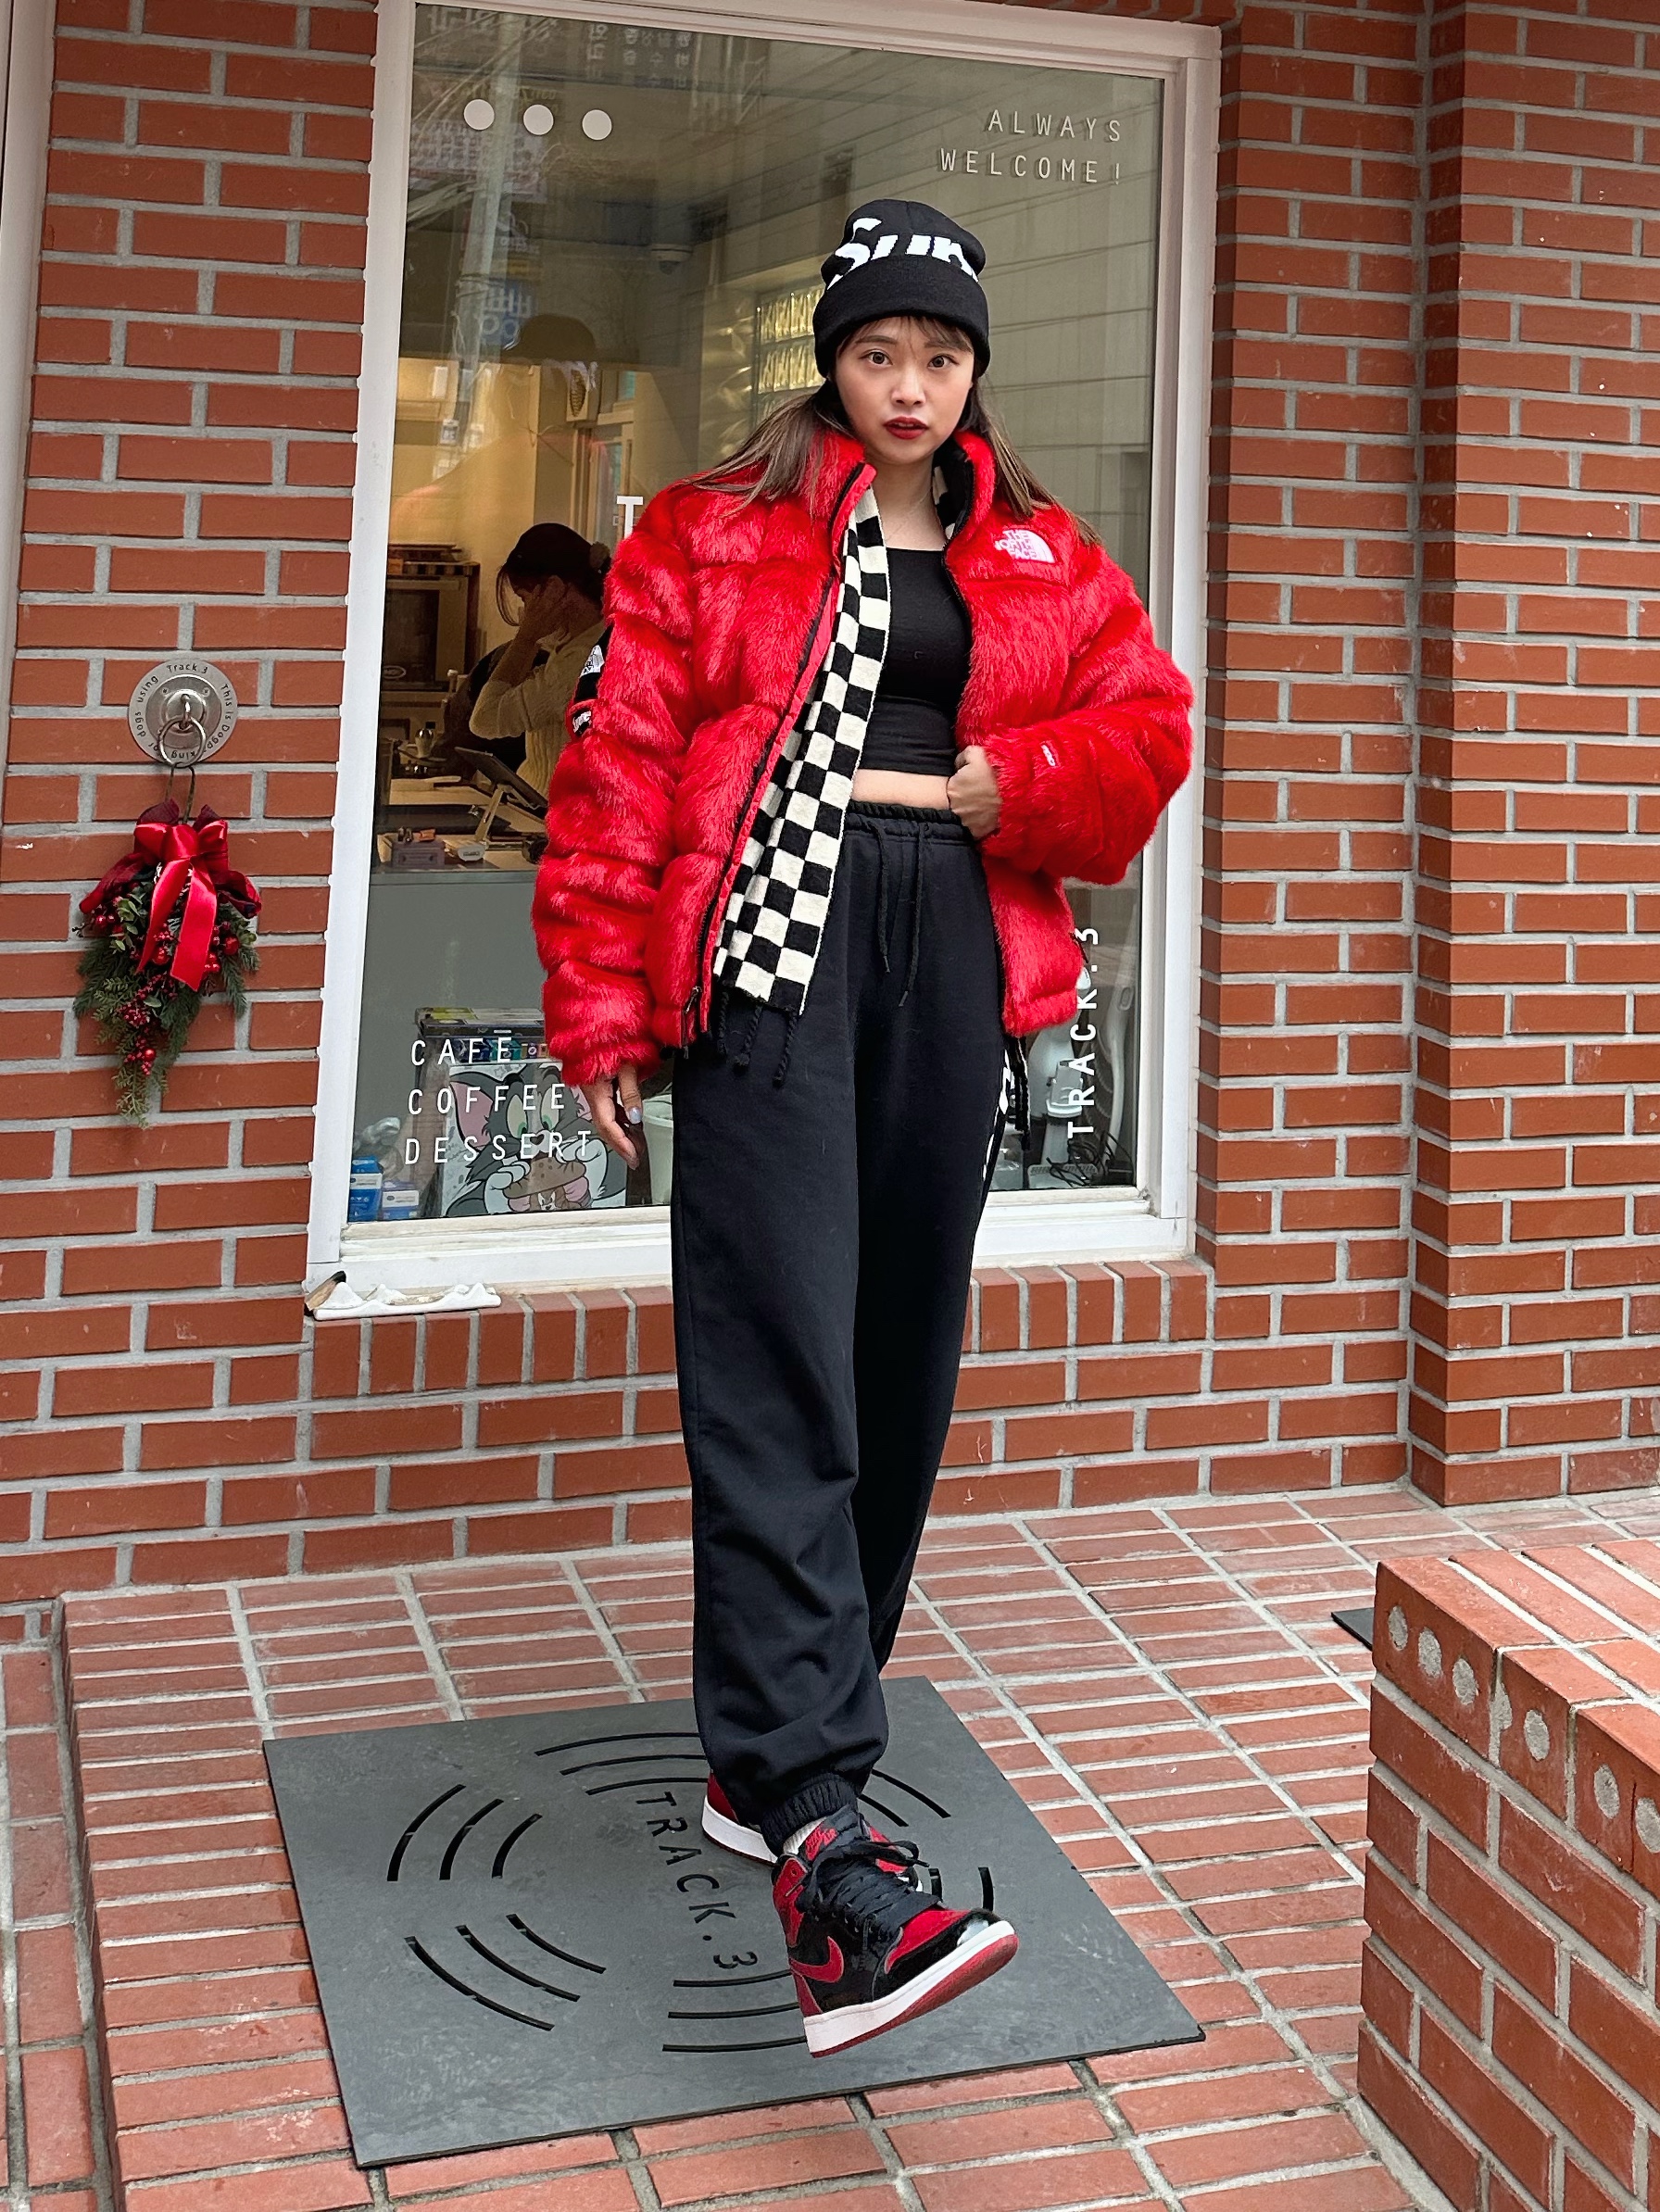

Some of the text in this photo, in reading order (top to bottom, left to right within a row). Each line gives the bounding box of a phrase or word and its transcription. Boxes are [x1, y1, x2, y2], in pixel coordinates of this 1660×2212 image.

[987, 108, 1122, 143] ALWAYS
[938, 147, 1121, 185] WELCOME!
[1002, 529, 1029, 539] THE
[167, 662, 208, 674] Track 3
[137, 675, 159, 703] using
[220, 684, 233, 707] This
[134, 711, 146, 737] dogs
[225, 710, 234, 721] is
[408, 1083, 565, 1115] COFFEE
[405, 1130, 592, 1165] DESSERT
[635, 1791, 759, 1969] TRACK.3
